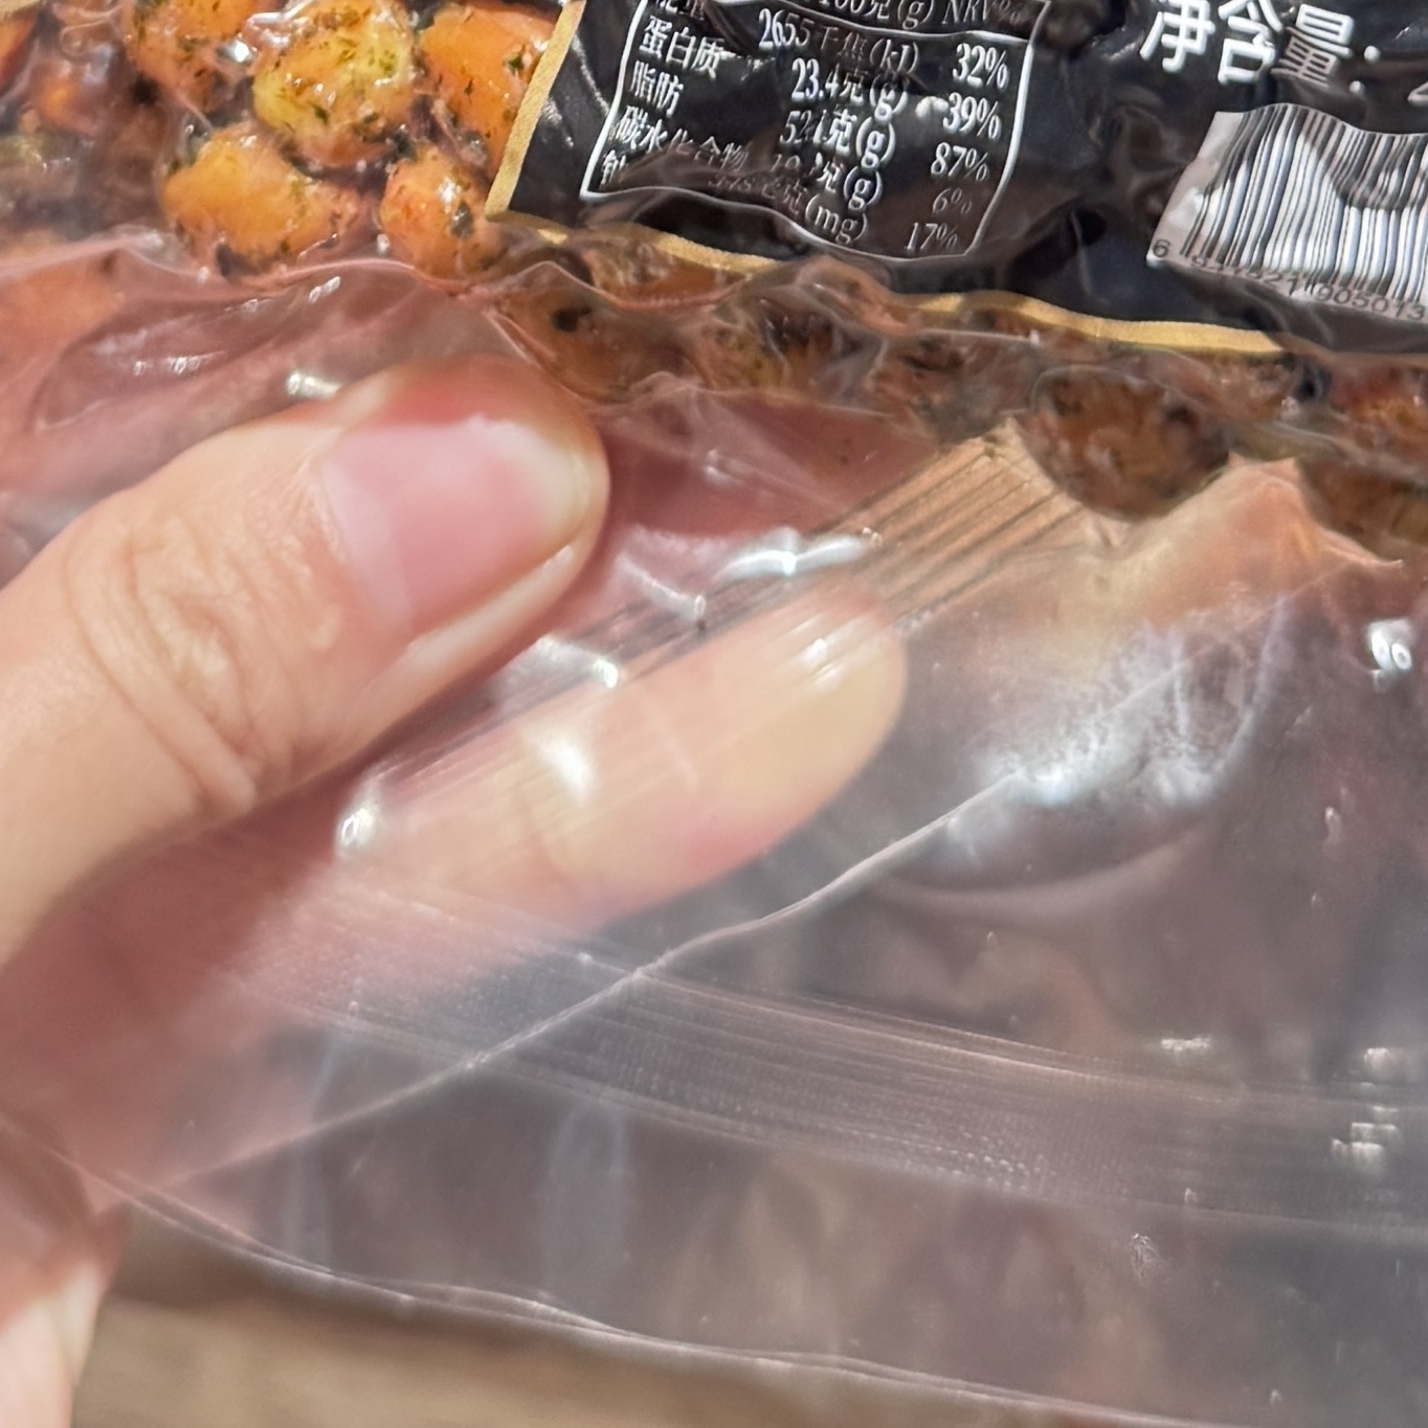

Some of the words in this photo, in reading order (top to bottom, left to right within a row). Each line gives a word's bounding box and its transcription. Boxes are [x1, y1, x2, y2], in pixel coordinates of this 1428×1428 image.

[639, 15, 721, 79] 蛋白质
[942, 91, 1002, 141] 39%
[952, 42, 1009, 90] 32%
[612, 105, 751, 171] 碳水化合物
[629, 60, 684, 119] 脂肪
[930, 141, 990, 183] 87%
[906, 220, 959, 253] 17%
[1151, 239, 1171, 259] 6
